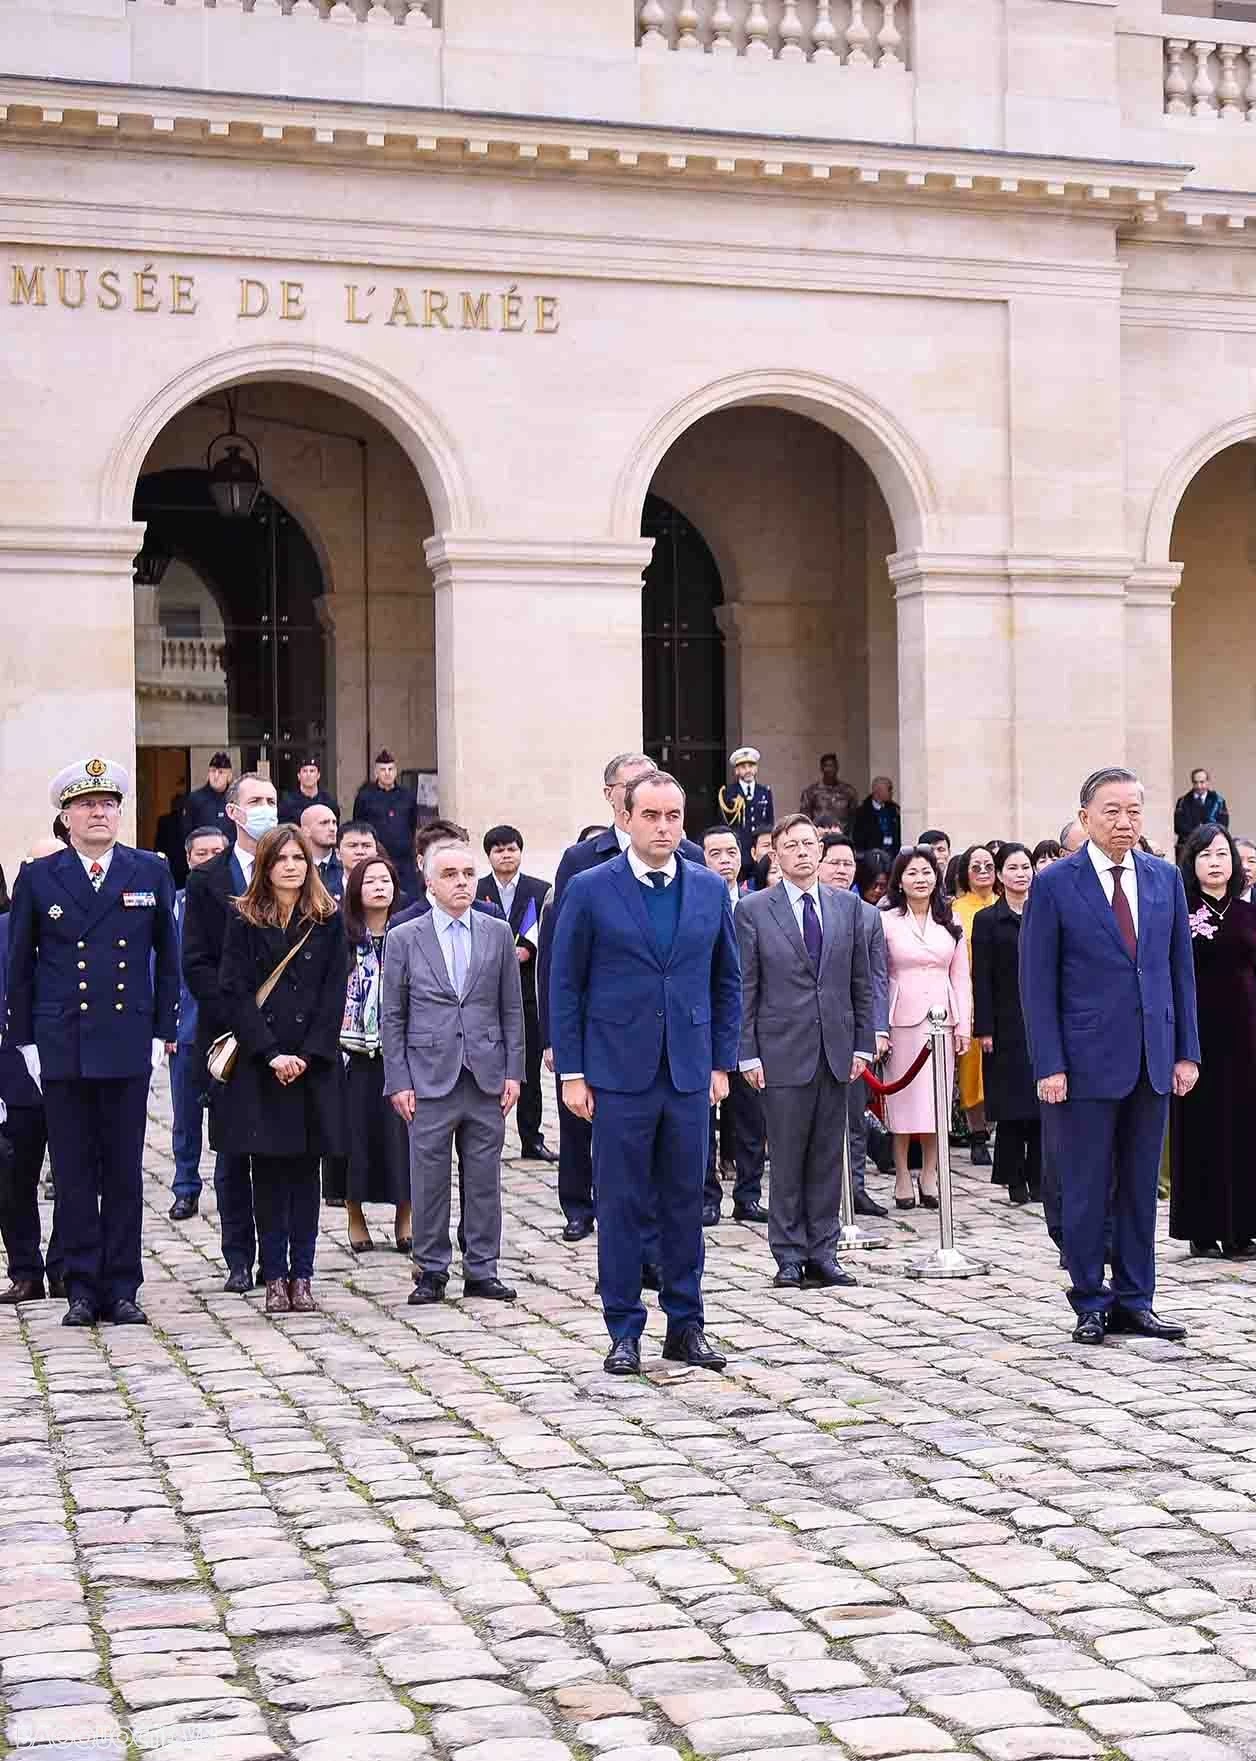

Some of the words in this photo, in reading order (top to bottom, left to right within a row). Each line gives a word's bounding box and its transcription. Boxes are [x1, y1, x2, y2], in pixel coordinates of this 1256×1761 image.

[9, 264, 200, 315] MUSÉE
[237, 279, 306, 320] DE
[344, 284, 561, 334] L'ARMÉE
